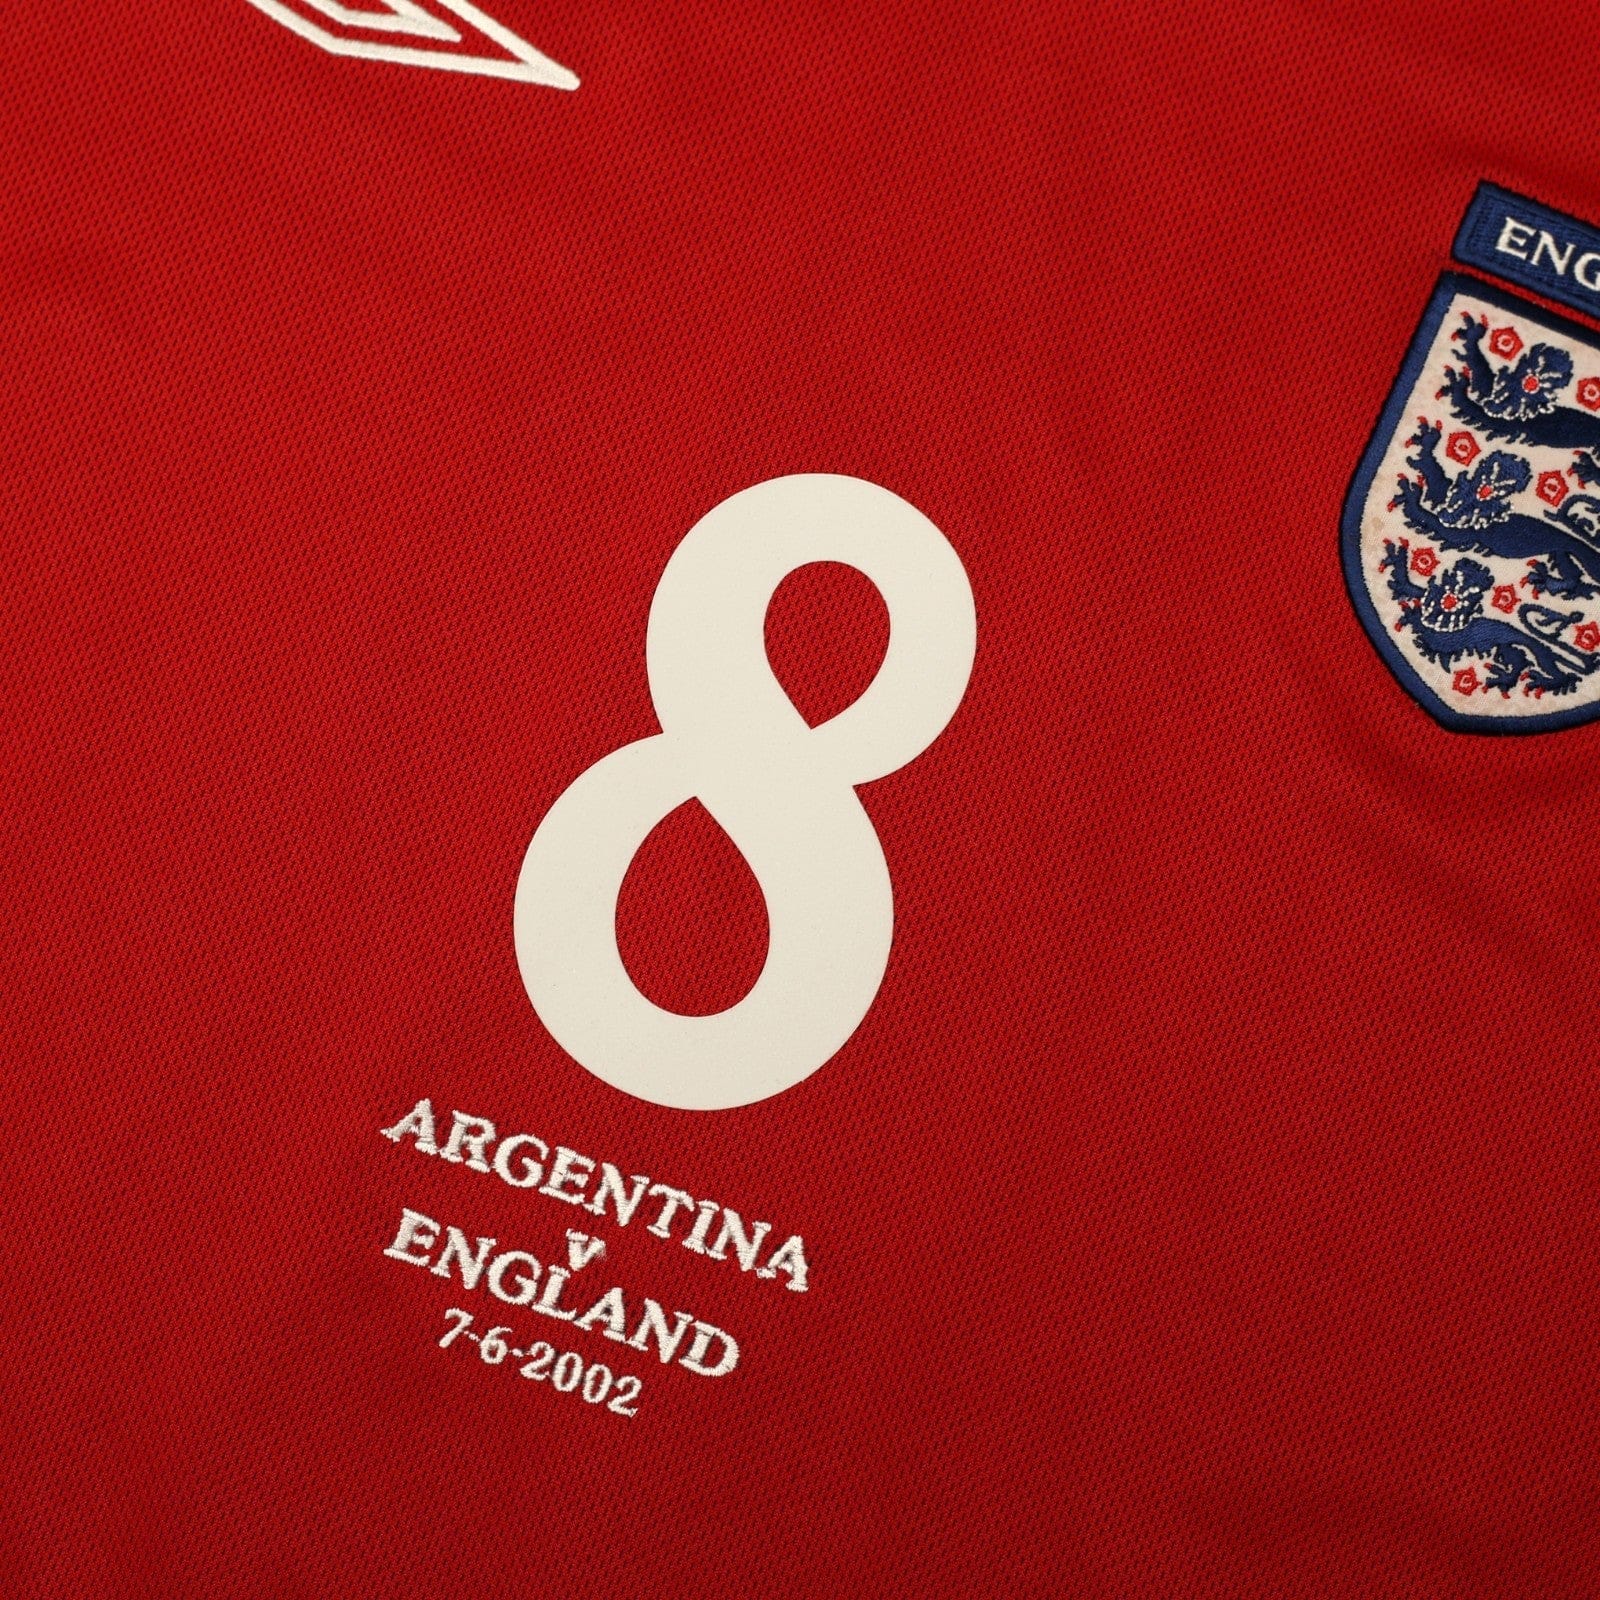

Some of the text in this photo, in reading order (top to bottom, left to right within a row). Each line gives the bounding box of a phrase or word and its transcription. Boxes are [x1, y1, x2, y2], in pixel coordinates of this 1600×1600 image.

[513, 472, 977, 1111] 8
[380, 1098, 809, 1292] ARGENTINA
[384, 1207, 740, 1377] ENGLAND
[438, 1308, 643, 1418] 7-6-2002
